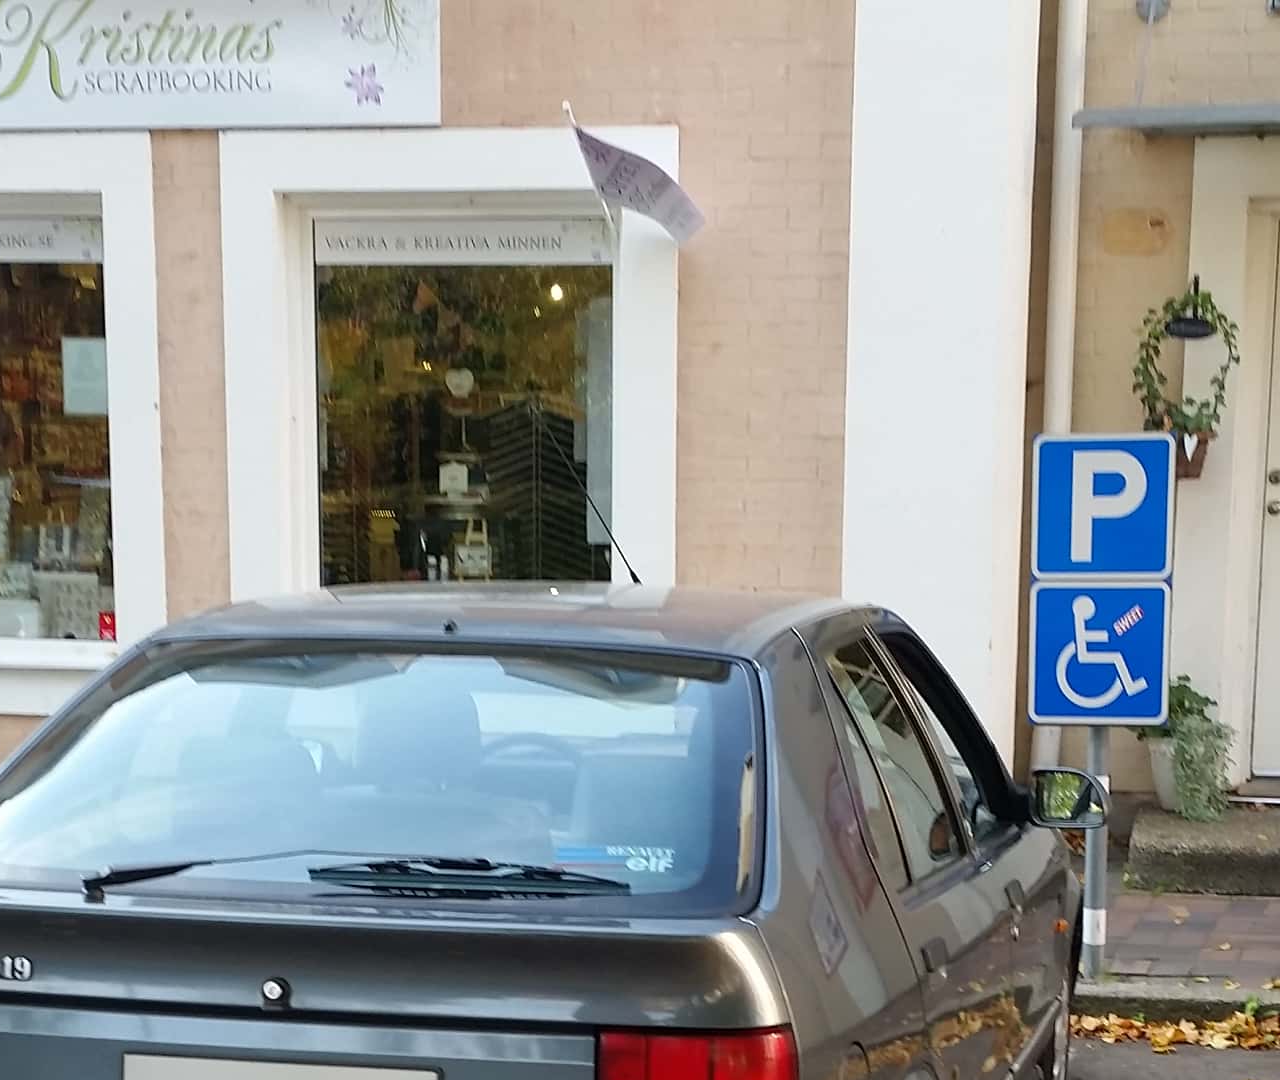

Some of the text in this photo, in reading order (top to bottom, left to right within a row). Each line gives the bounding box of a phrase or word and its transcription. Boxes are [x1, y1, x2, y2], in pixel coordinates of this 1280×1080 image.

[83, 69, 273, 96] SCRAPBOOKING
[324, 235, 563, 250] VACKRA & KREATIVA MINNEN
[1070, 450, 1148, 563] P
[2, 955, 33, 981] 19
